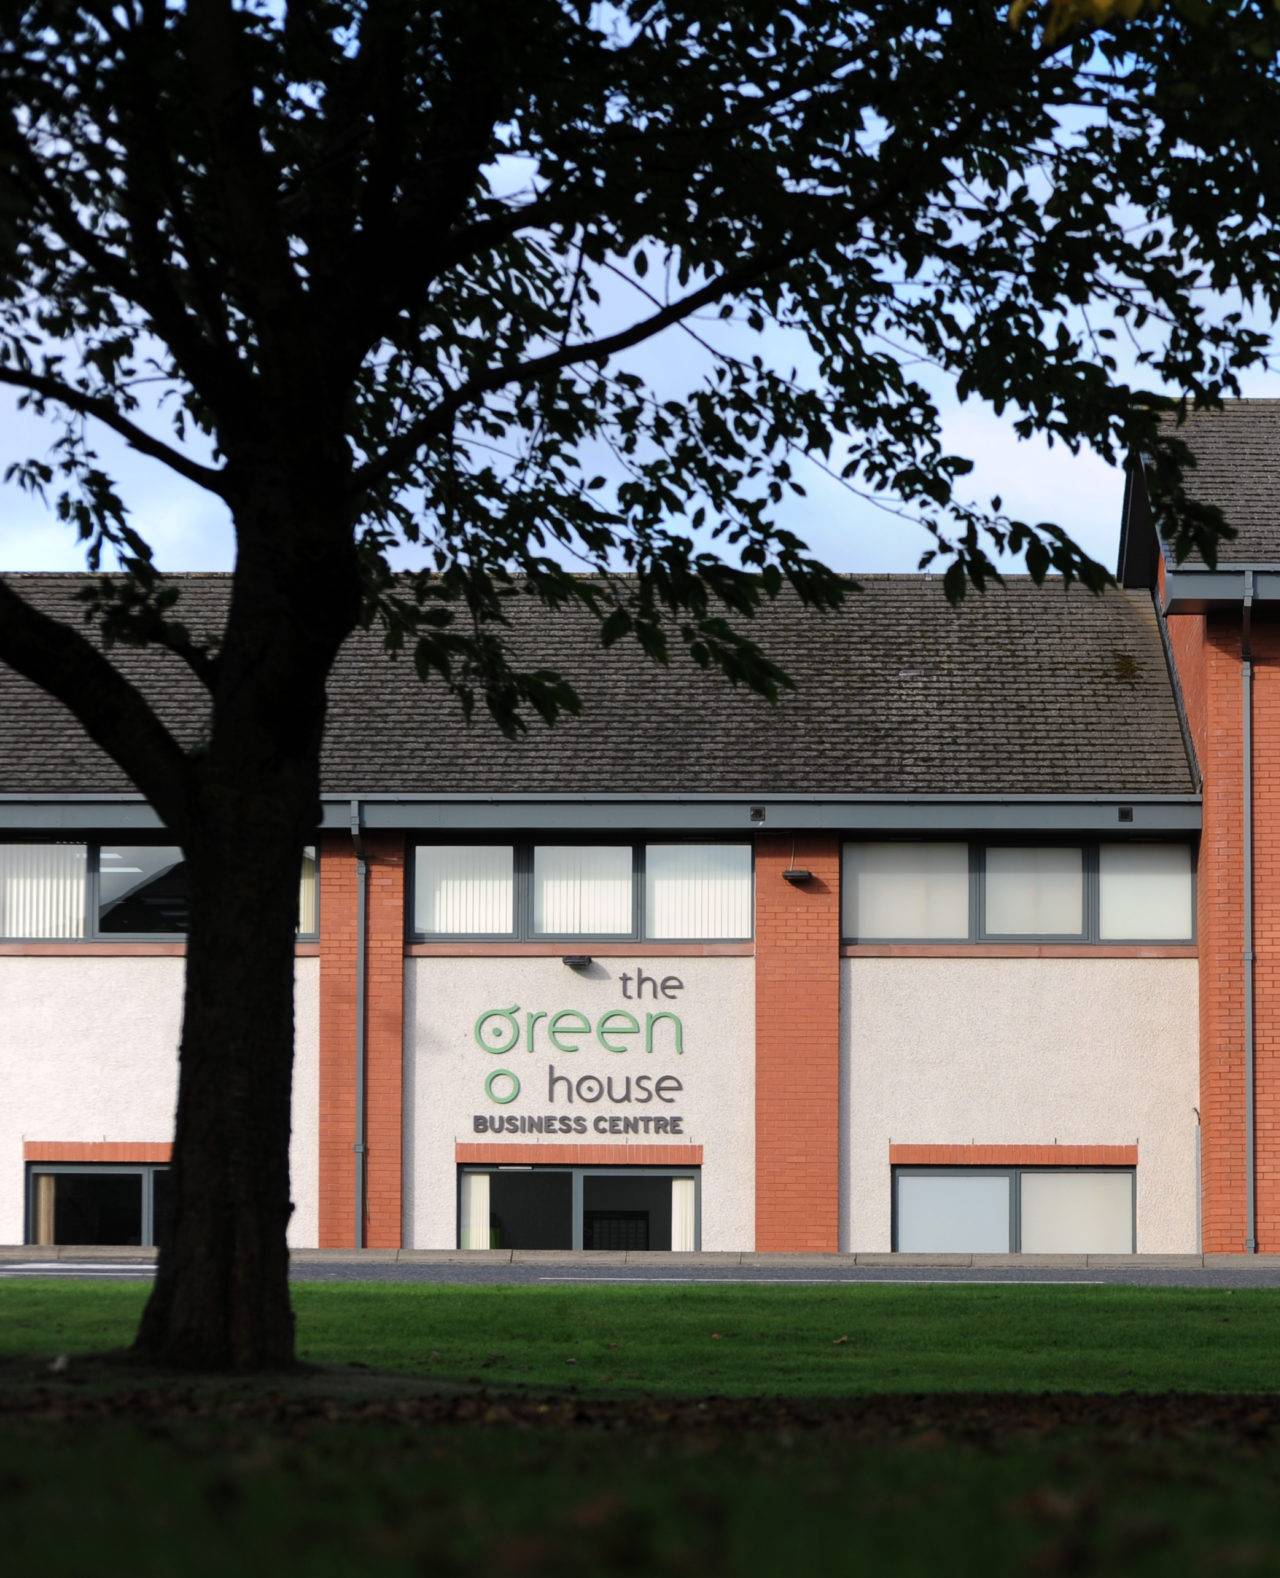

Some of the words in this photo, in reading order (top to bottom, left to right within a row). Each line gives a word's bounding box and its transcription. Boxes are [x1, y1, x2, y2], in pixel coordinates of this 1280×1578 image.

[618, 967, 684, 1000] the
[548, 1064, 683, 1104] house
[473, 1115, 588, 1134] BUSINESS
[593, 1115, 684, 1134] CENTRE
